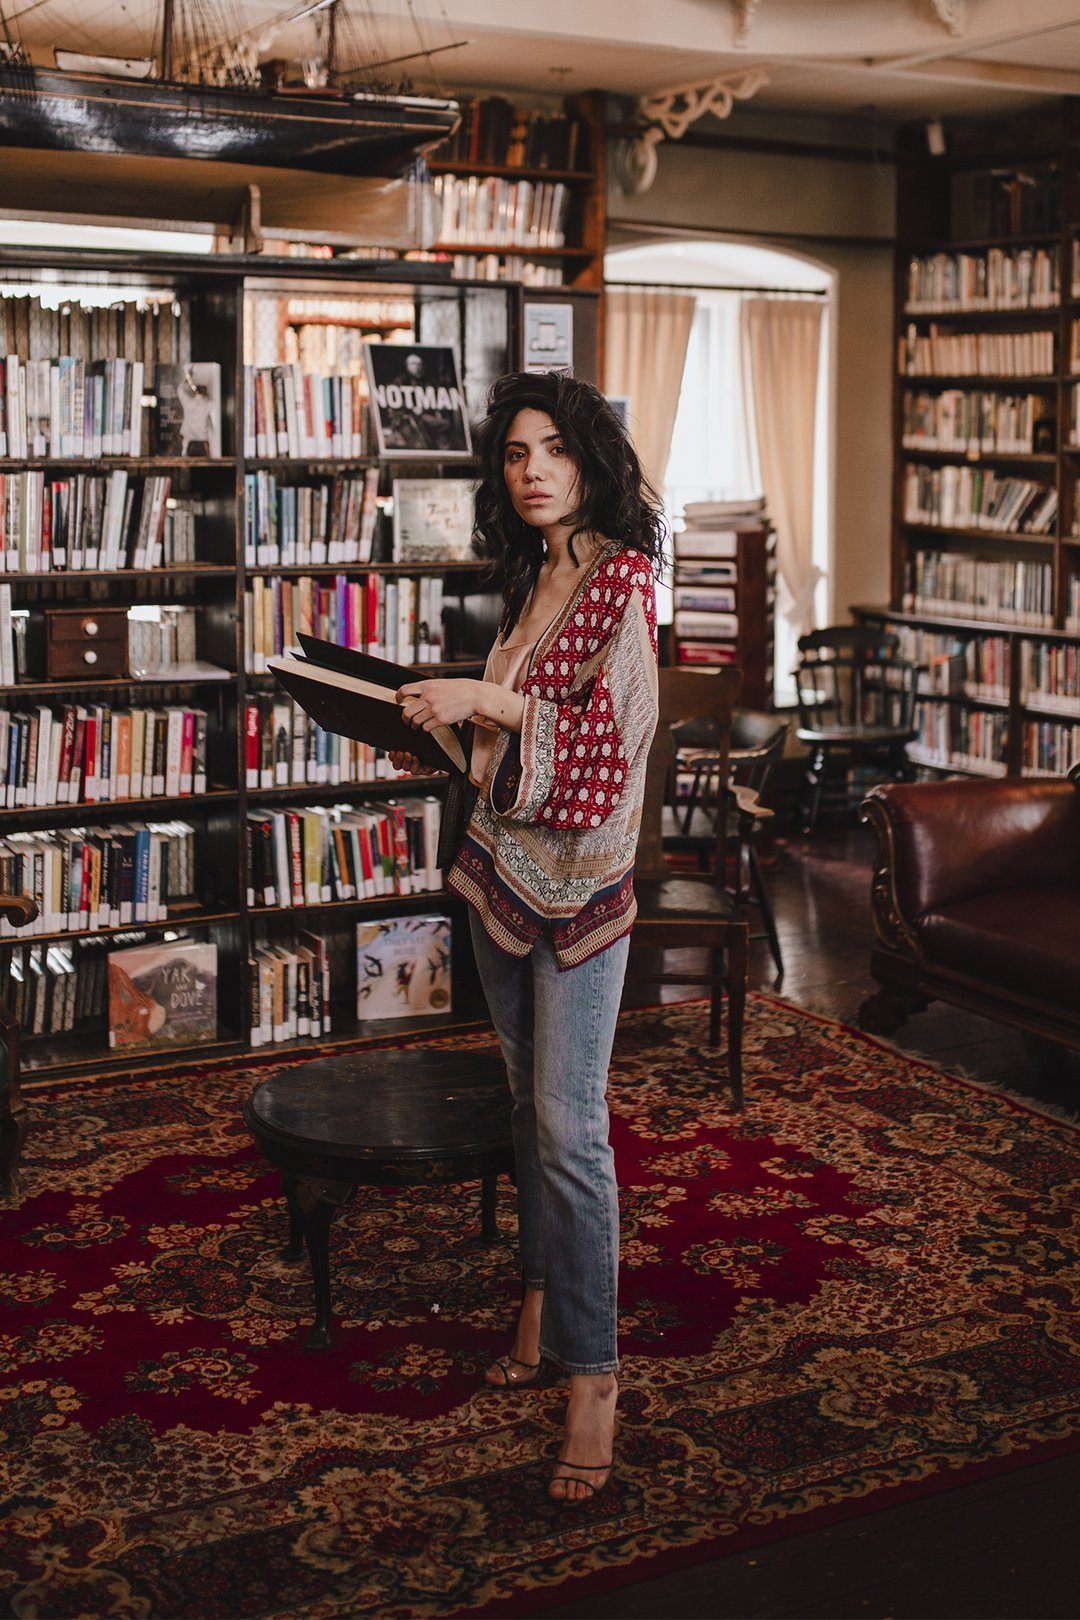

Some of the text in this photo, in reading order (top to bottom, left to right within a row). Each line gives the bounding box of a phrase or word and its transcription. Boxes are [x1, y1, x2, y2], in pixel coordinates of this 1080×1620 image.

[372, 384, 461, 415] NOTMAN
[162, 966, 192, 984] YAK
[170, 990, 204, 1008] DOVE
